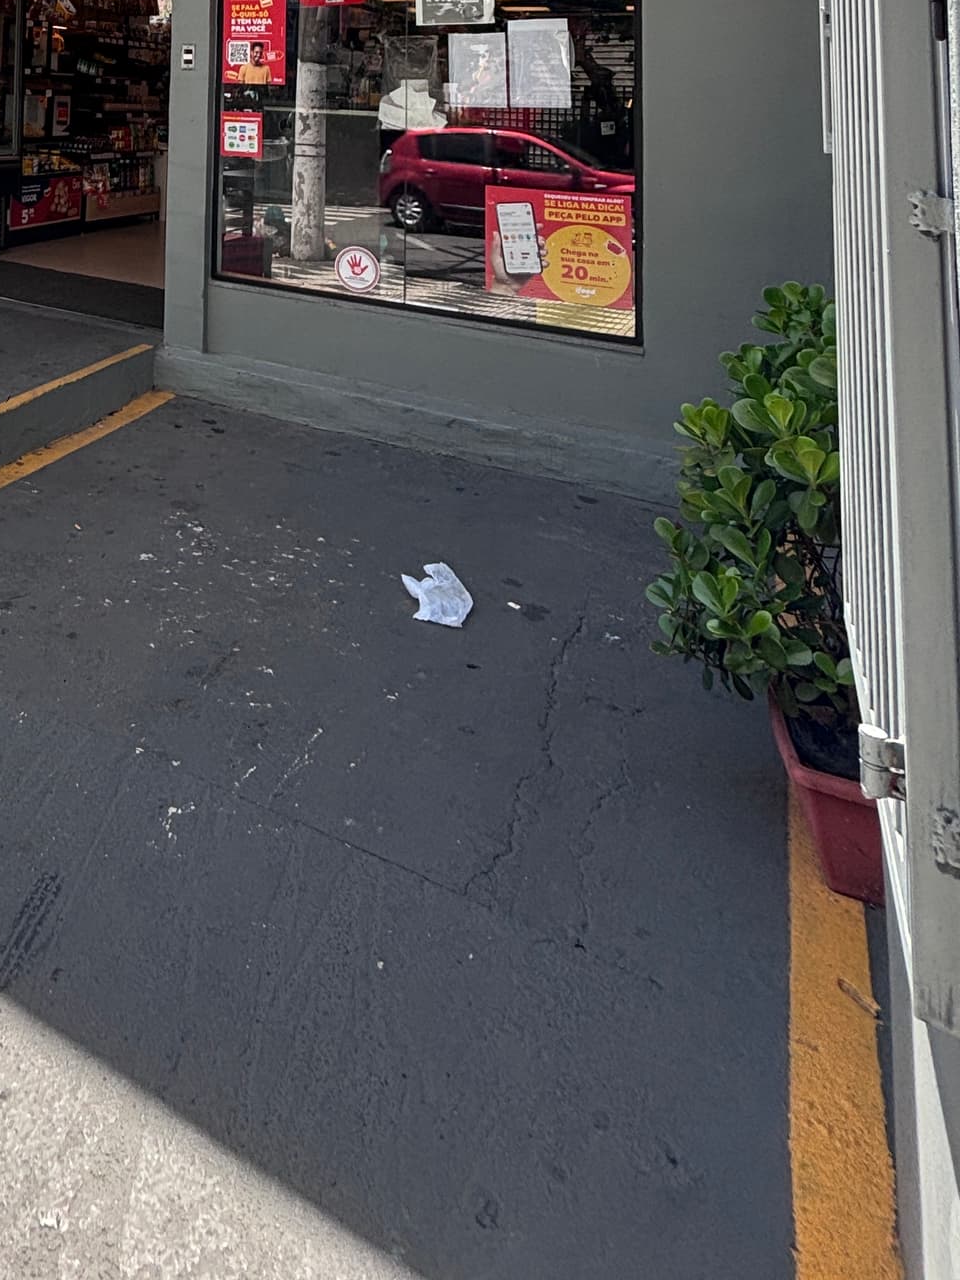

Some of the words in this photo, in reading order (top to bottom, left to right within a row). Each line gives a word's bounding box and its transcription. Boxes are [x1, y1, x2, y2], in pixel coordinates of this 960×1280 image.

[246, 24, 266, 32] VOCÊ
[558, 201, 580, 209] LIGA
[581, 202, 597, 210] NA
[597, 203, 625, 212] DICA!
[548, 210, 574, 220] PEÇA
[575, 212, 600, 222] PELO
[602, 215, 623, 223] APP
[560, 247, 587, 257] Chega
[561, 264, 588, 281] 20
